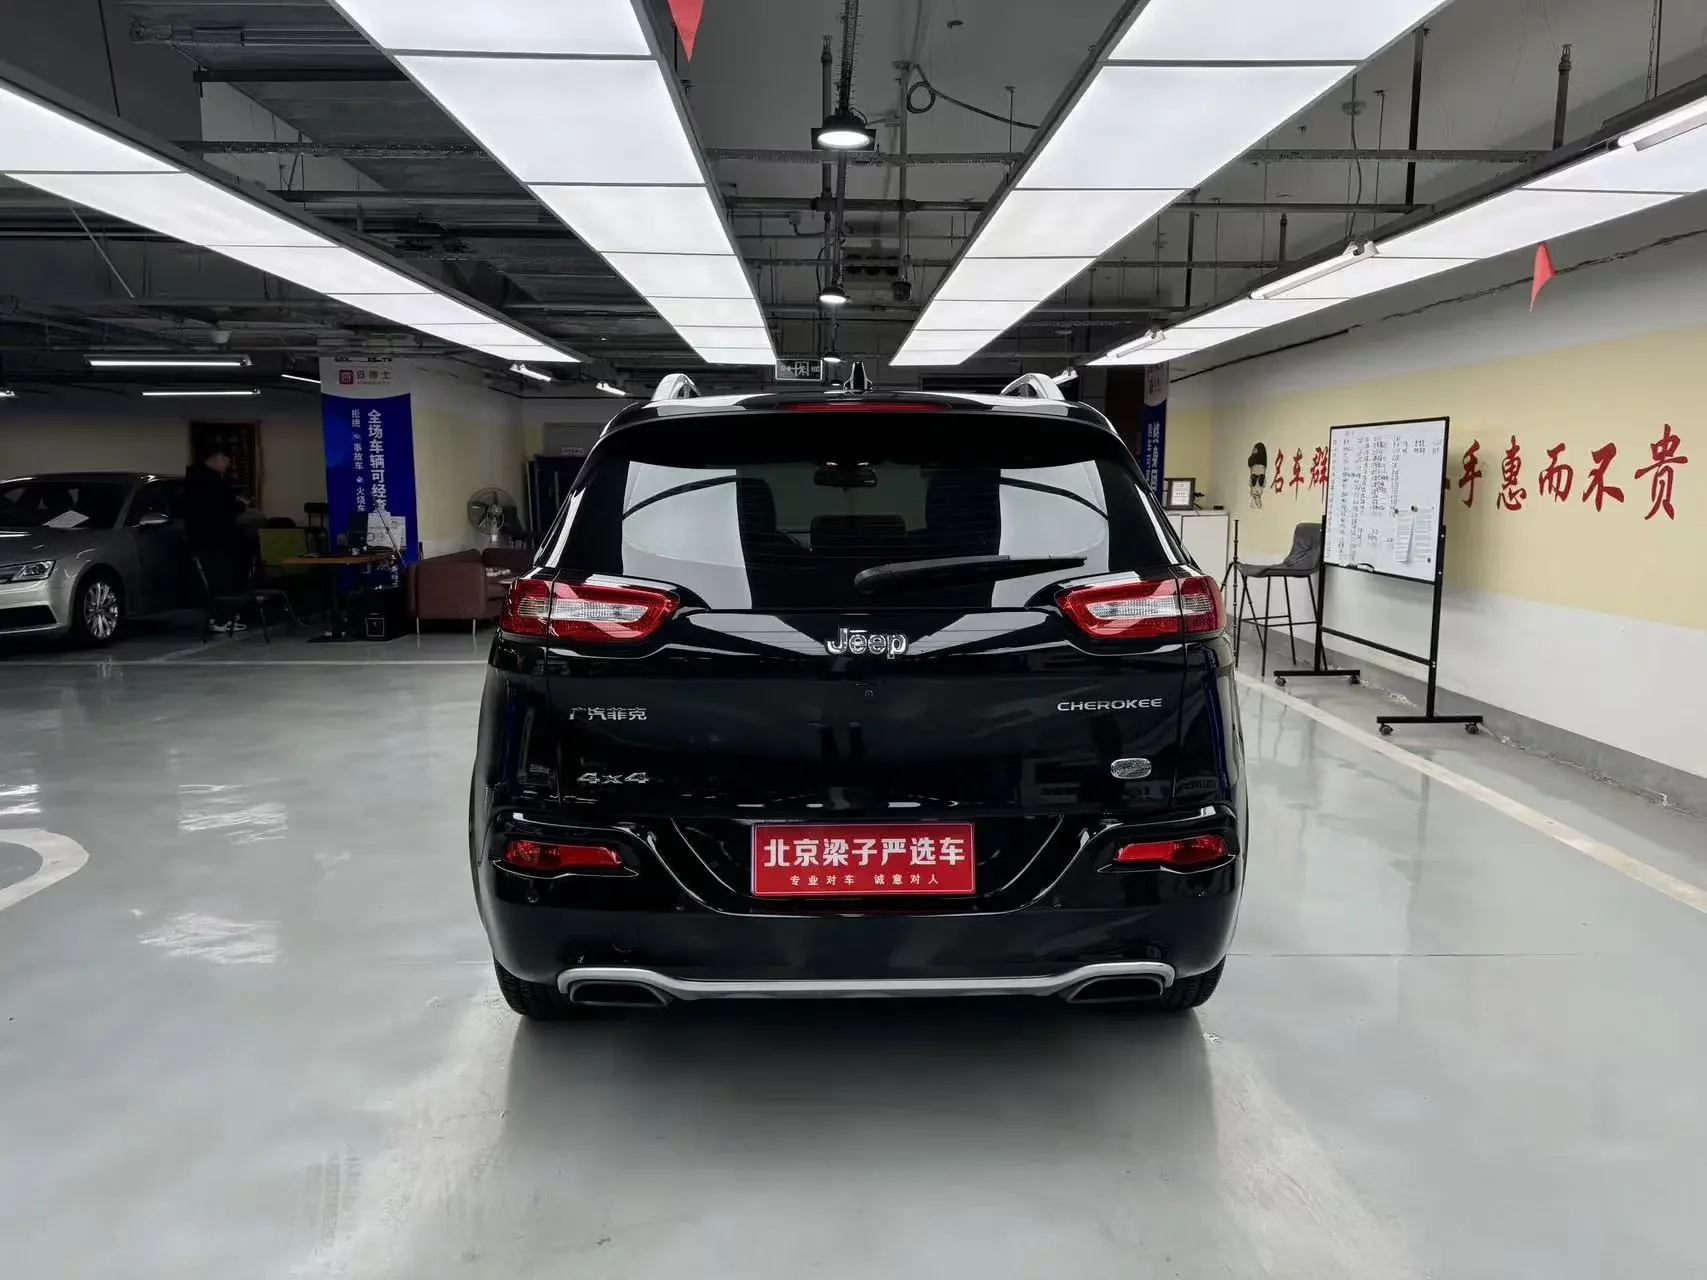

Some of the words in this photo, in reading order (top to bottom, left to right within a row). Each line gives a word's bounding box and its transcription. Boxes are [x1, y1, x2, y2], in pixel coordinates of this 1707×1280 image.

[1445, 423, 1689, 521] 手惠而不贵
[827, 627, 907, 660] Jeep
[568, 706, 647, 721] 广汽菲克
[1056, 698, 1163, 711] CHEROKEE
[763, 837, 966, 867] 北京梁子严选车
[790, 875, 855, 886] 专业对车
[874, 873, 939, 885] 诚意对人
